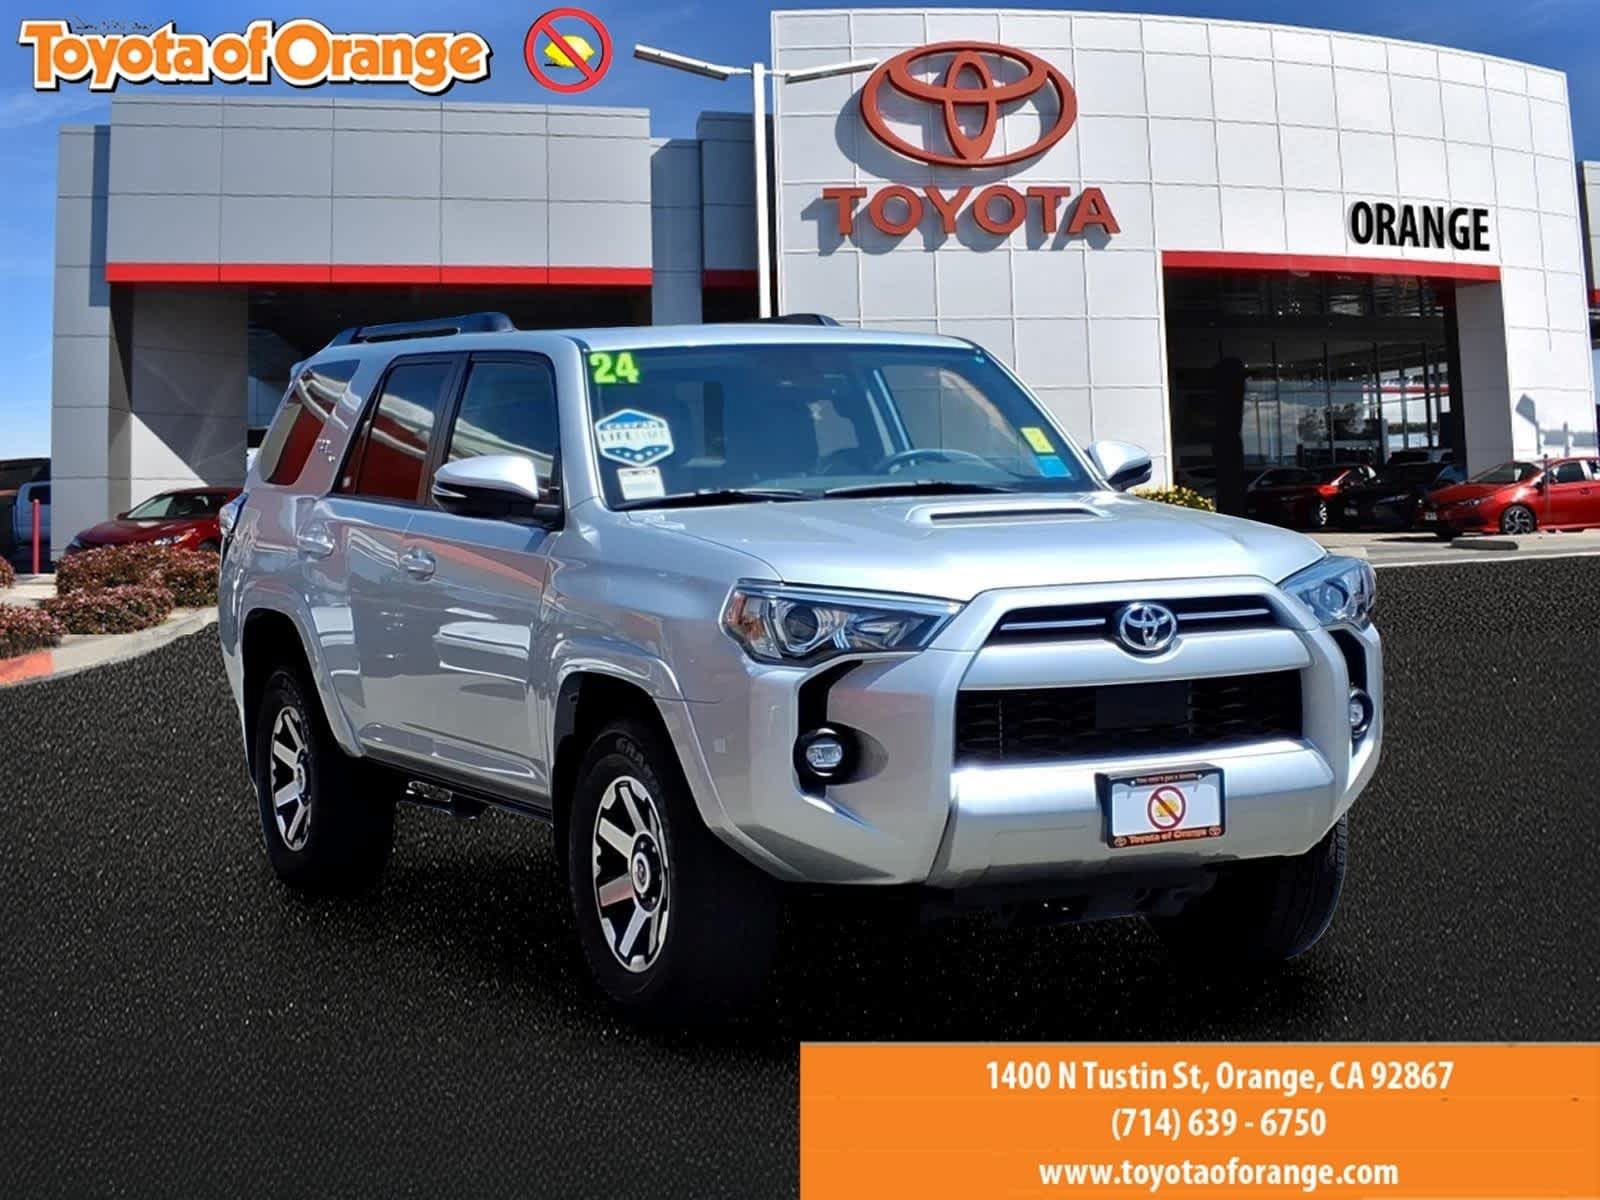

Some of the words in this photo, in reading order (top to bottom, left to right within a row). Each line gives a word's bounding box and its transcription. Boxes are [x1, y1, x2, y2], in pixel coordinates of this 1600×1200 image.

[822, 185, 1120, 236] TOYOTA
[1350, 201, 1491, 251] ORANGE
[588, 351, 640, 384] 24
